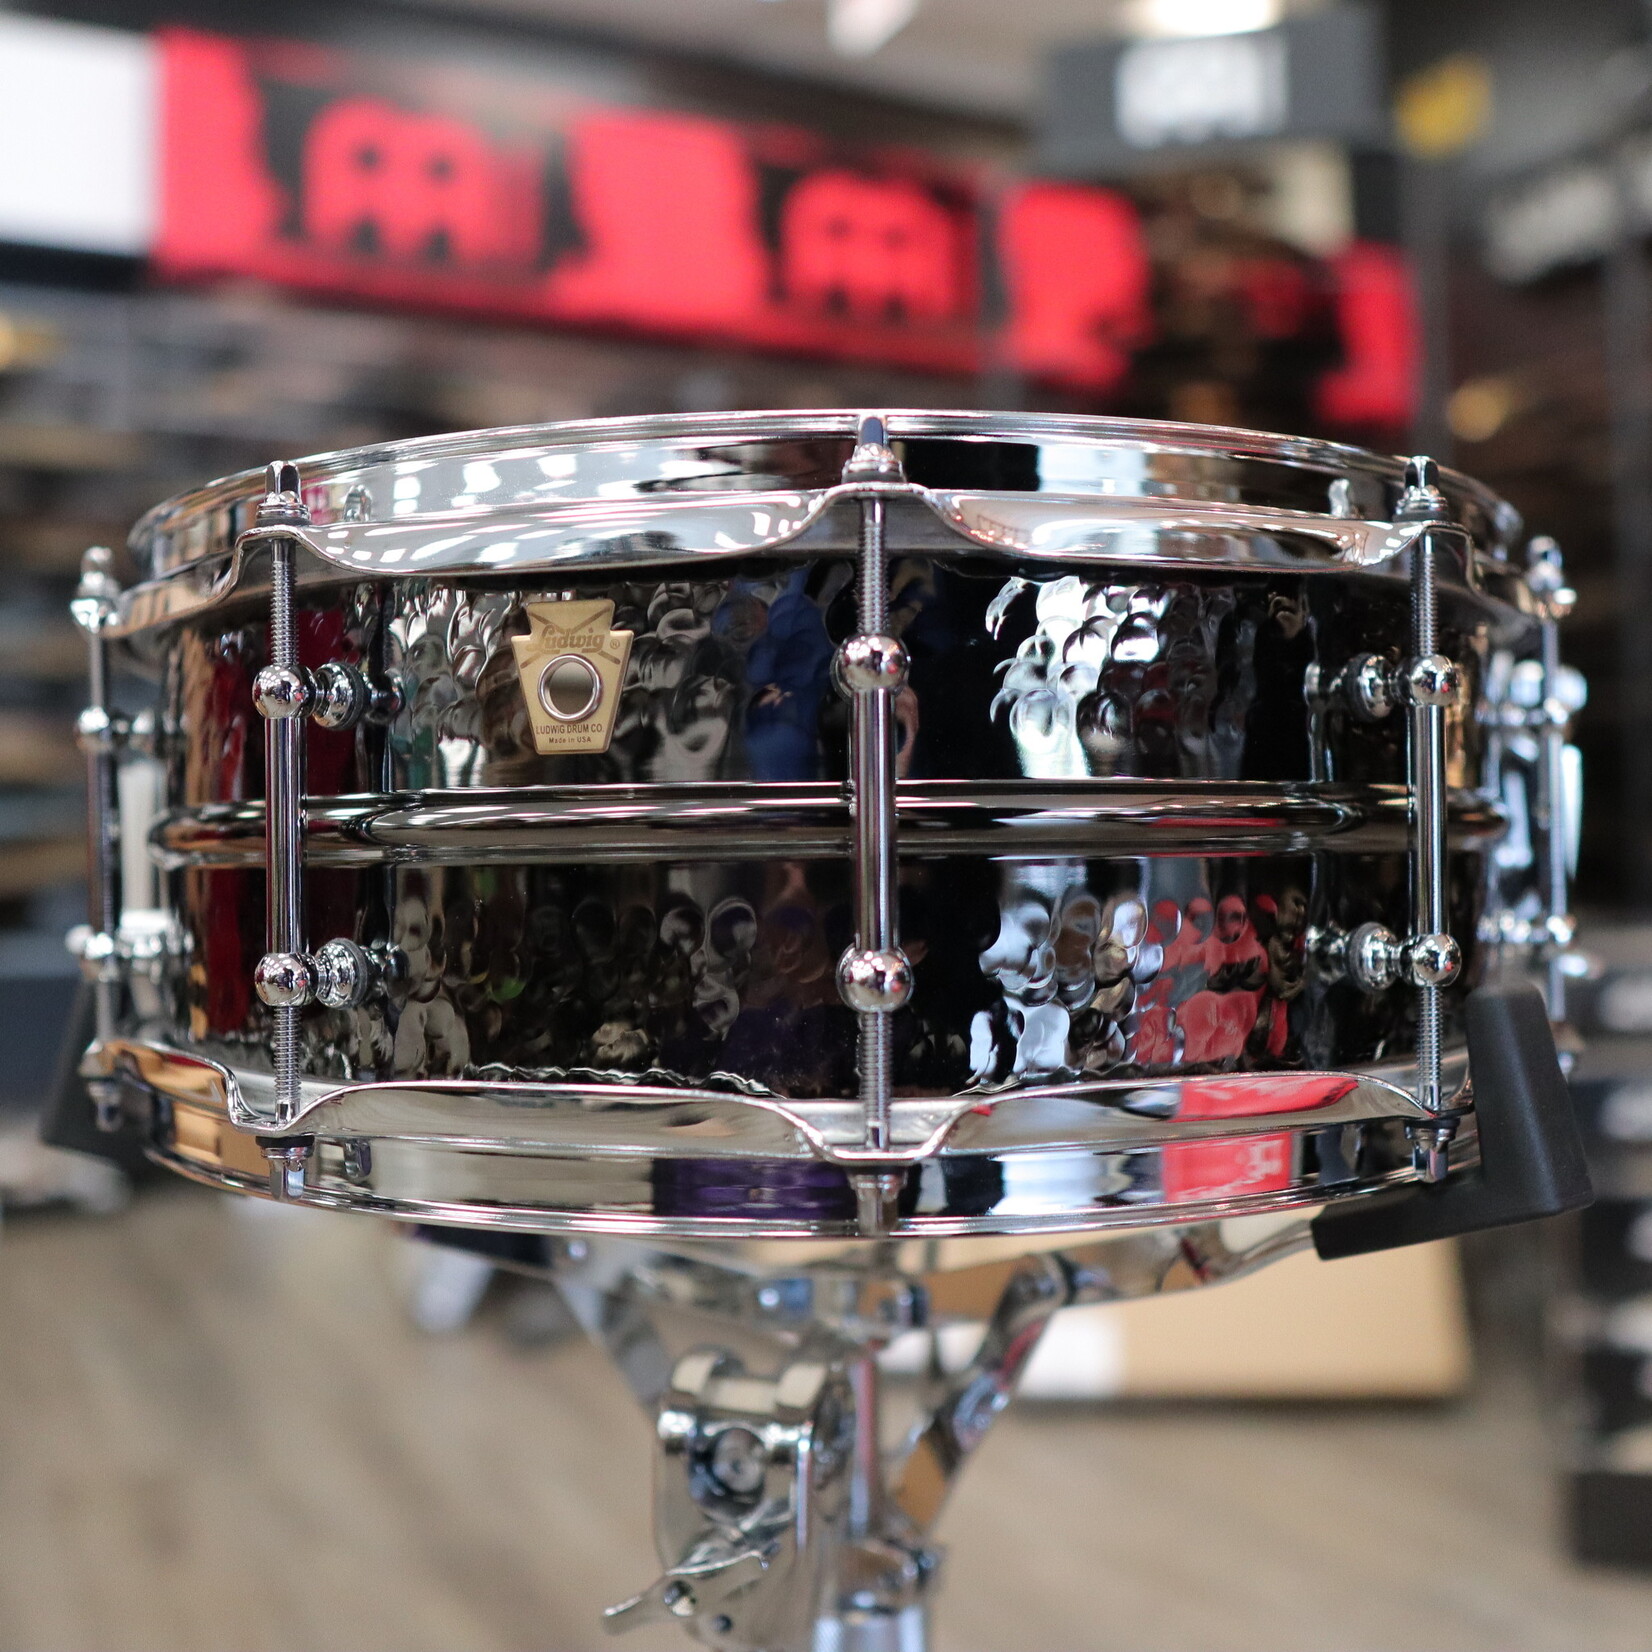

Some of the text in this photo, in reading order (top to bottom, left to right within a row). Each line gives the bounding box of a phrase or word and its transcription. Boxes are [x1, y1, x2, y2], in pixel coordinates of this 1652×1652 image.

[527, 624, 605, 654] Ludwig
[536, 725, 564, 735] LUDWIG
[567, 724, 589, 733] DRUM
